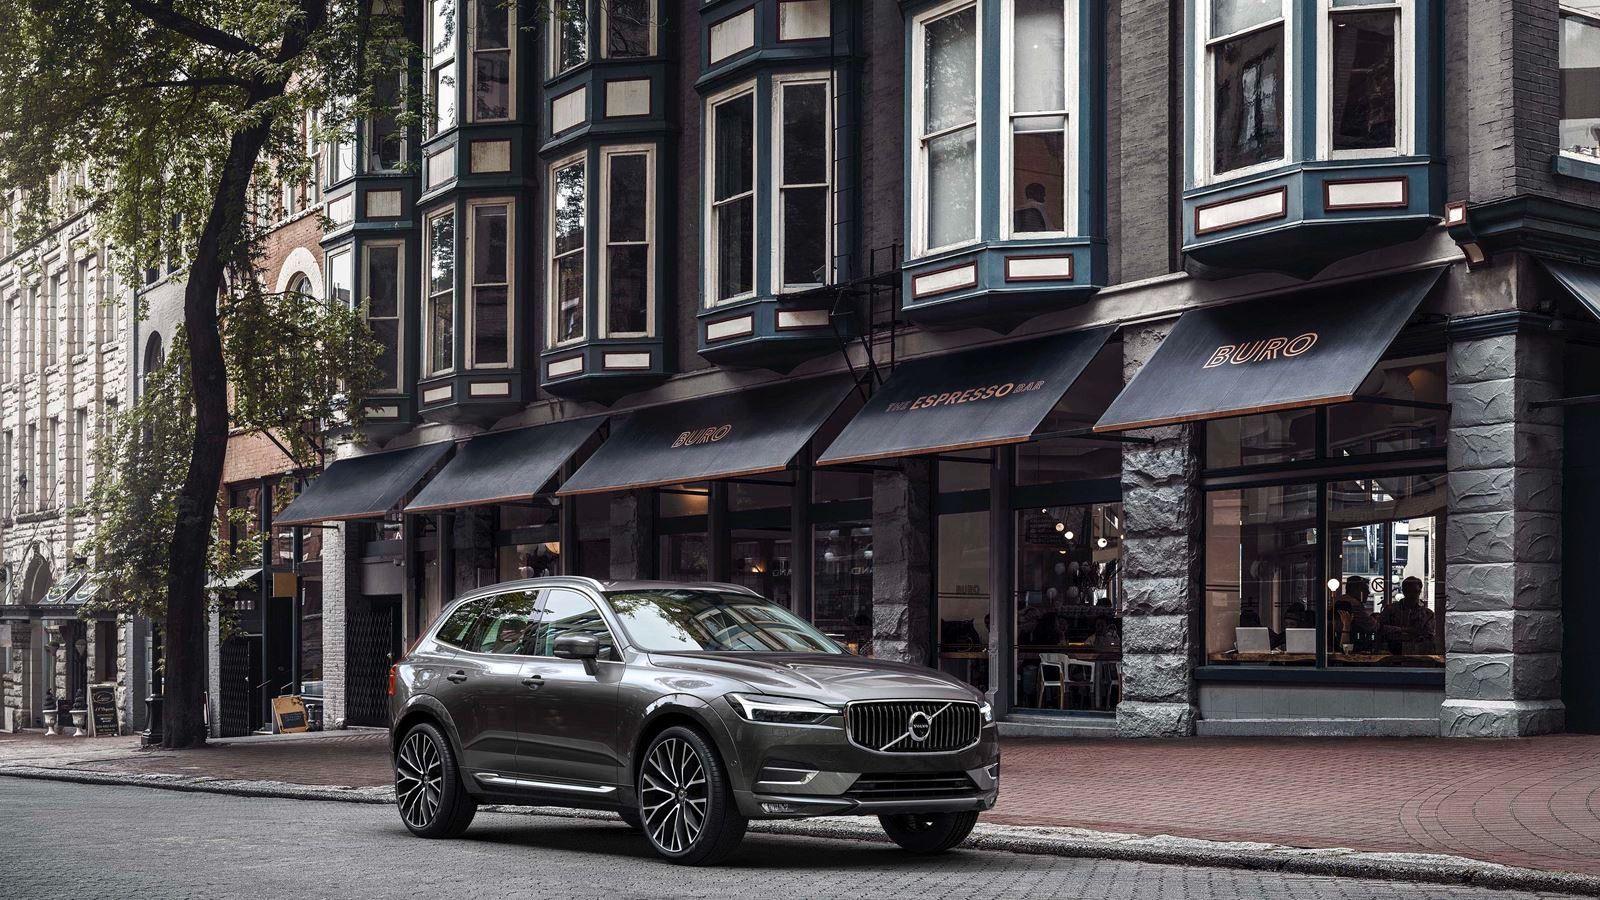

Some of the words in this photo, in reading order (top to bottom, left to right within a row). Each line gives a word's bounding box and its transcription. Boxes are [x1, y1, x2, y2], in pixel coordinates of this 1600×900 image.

[1202, 332, 1318, 369] BURO
[885, 400, 910, 412] THE
[909, 383, 1014, 410] ESPRESSO
[1013, 380, 1045, 394] BAR
[671, 424, 732, 448] BURO
